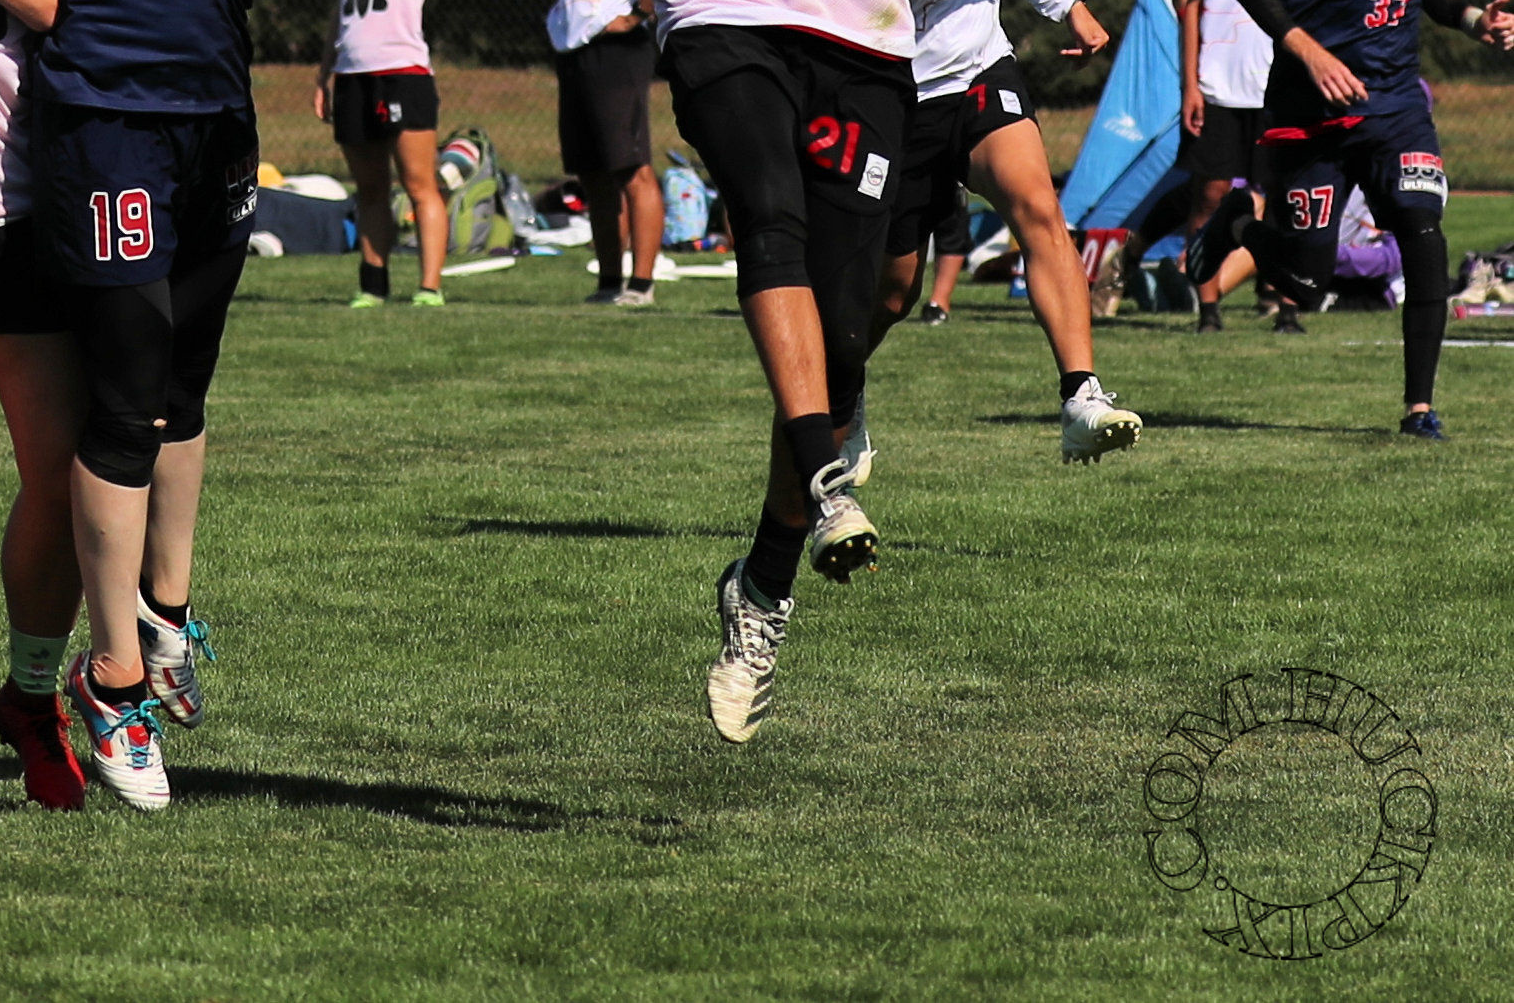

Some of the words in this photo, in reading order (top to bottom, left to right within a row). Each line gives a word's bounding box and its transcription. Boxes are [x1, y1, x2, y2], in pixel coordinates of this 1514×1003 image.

[808, 115, 862, 175] 21
[89, 187, 154, 262] 19
[1287, 184, 1335, 230] 37
